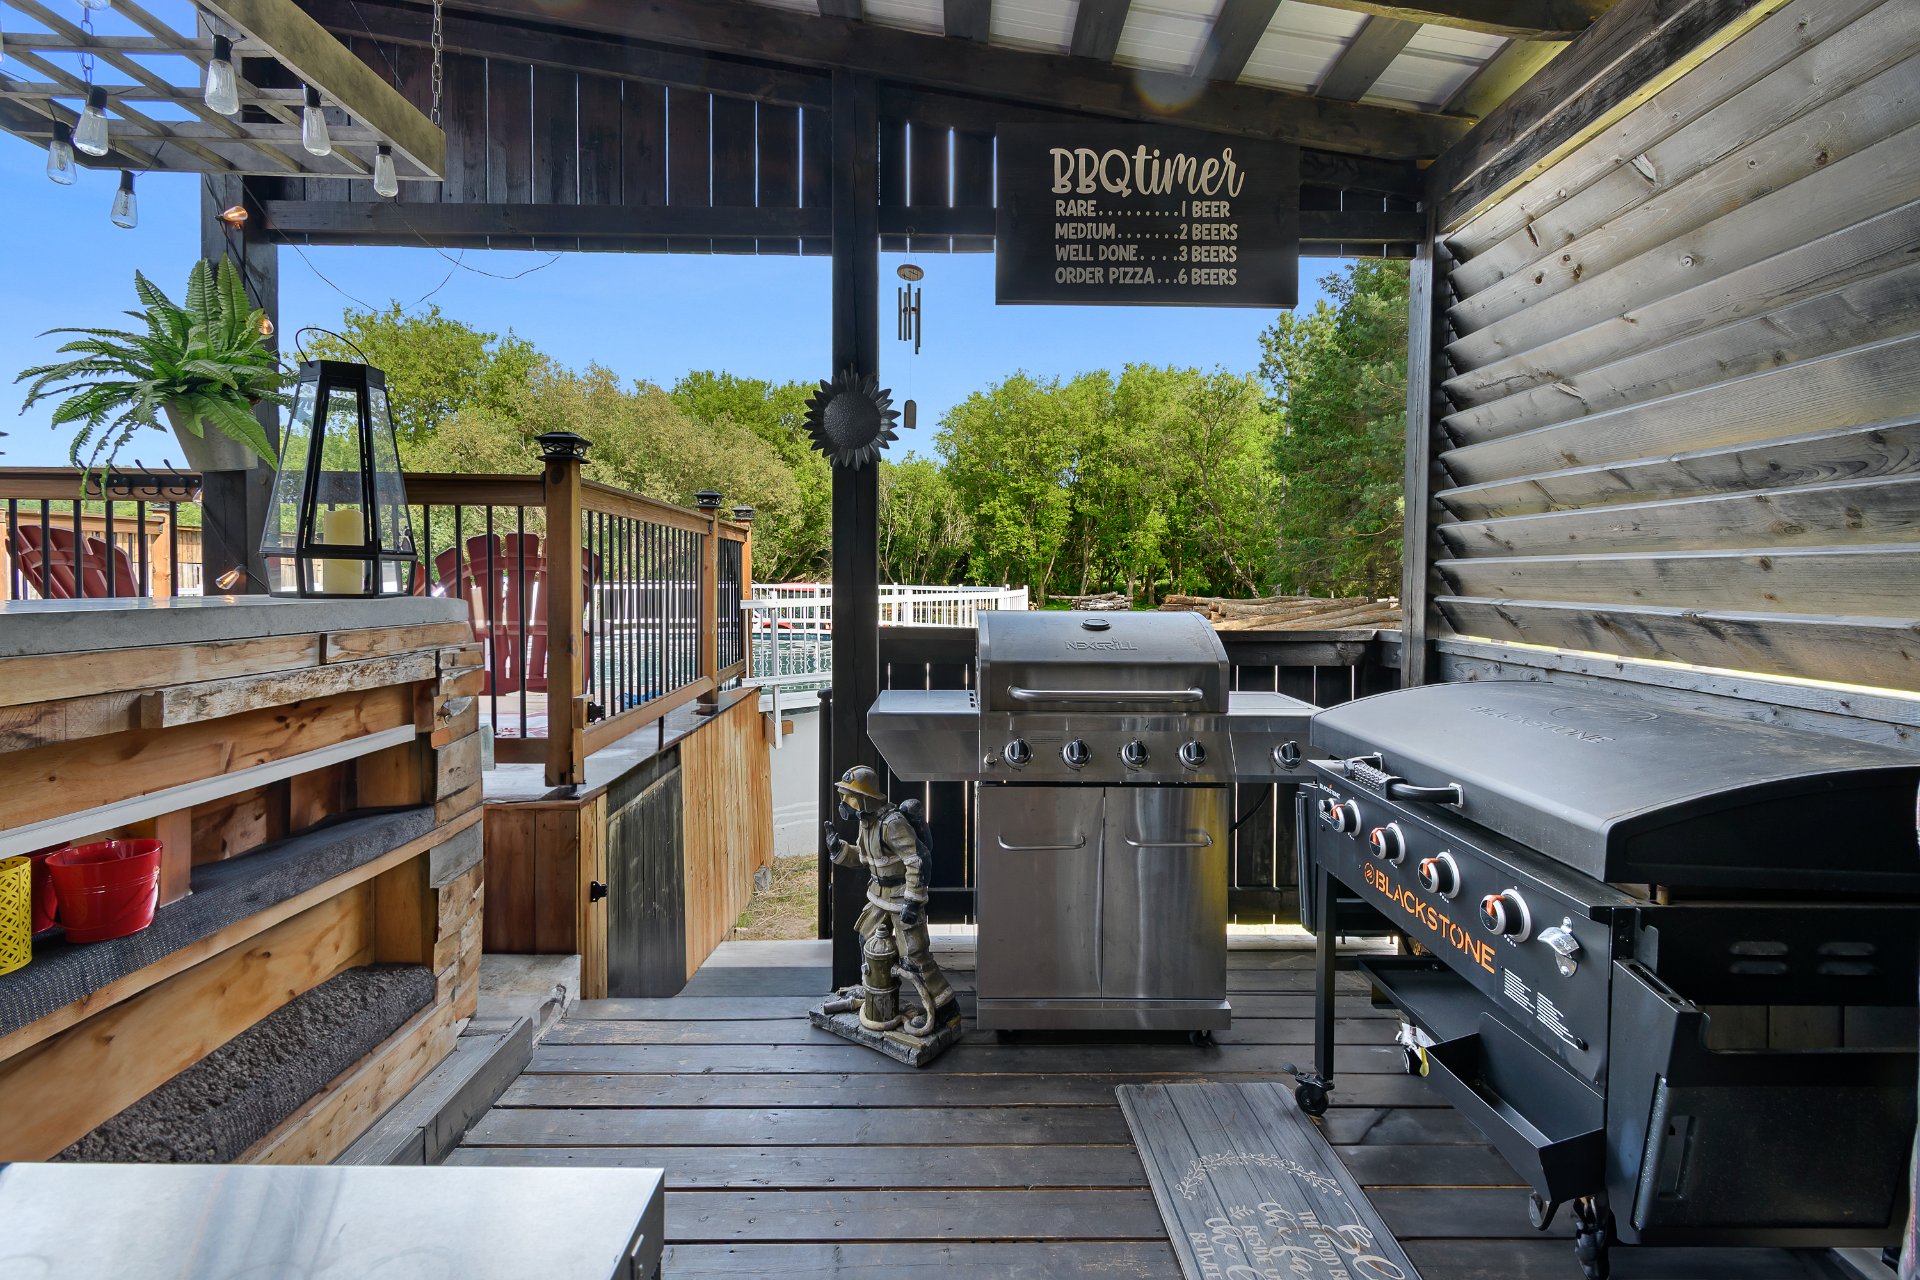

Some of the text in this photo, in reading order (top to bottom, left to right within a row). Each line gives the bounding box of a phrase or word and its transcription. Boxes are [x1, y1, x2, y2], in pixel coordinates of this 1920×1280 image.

[1192, 201, 1230, 218] BEER
[1192, 223, 1238, 241] BEERS
[1055, 244, 1094, 261] WELL
[1191, 246, 1237, 263] BEERS
[1054, 267, 1105, 284] ORDER
[1191, 268, 1237, 286] BEERS
[1375, 869, 1496, 974] BLACKSTONE
[1204, 1207, 1246, 1260] the
[1241, 1225, 1273, 1266] BESIDE
[1297, 1211, 1320, 1231] THE
[1309, 1234, 1342, 1267] FOOD
